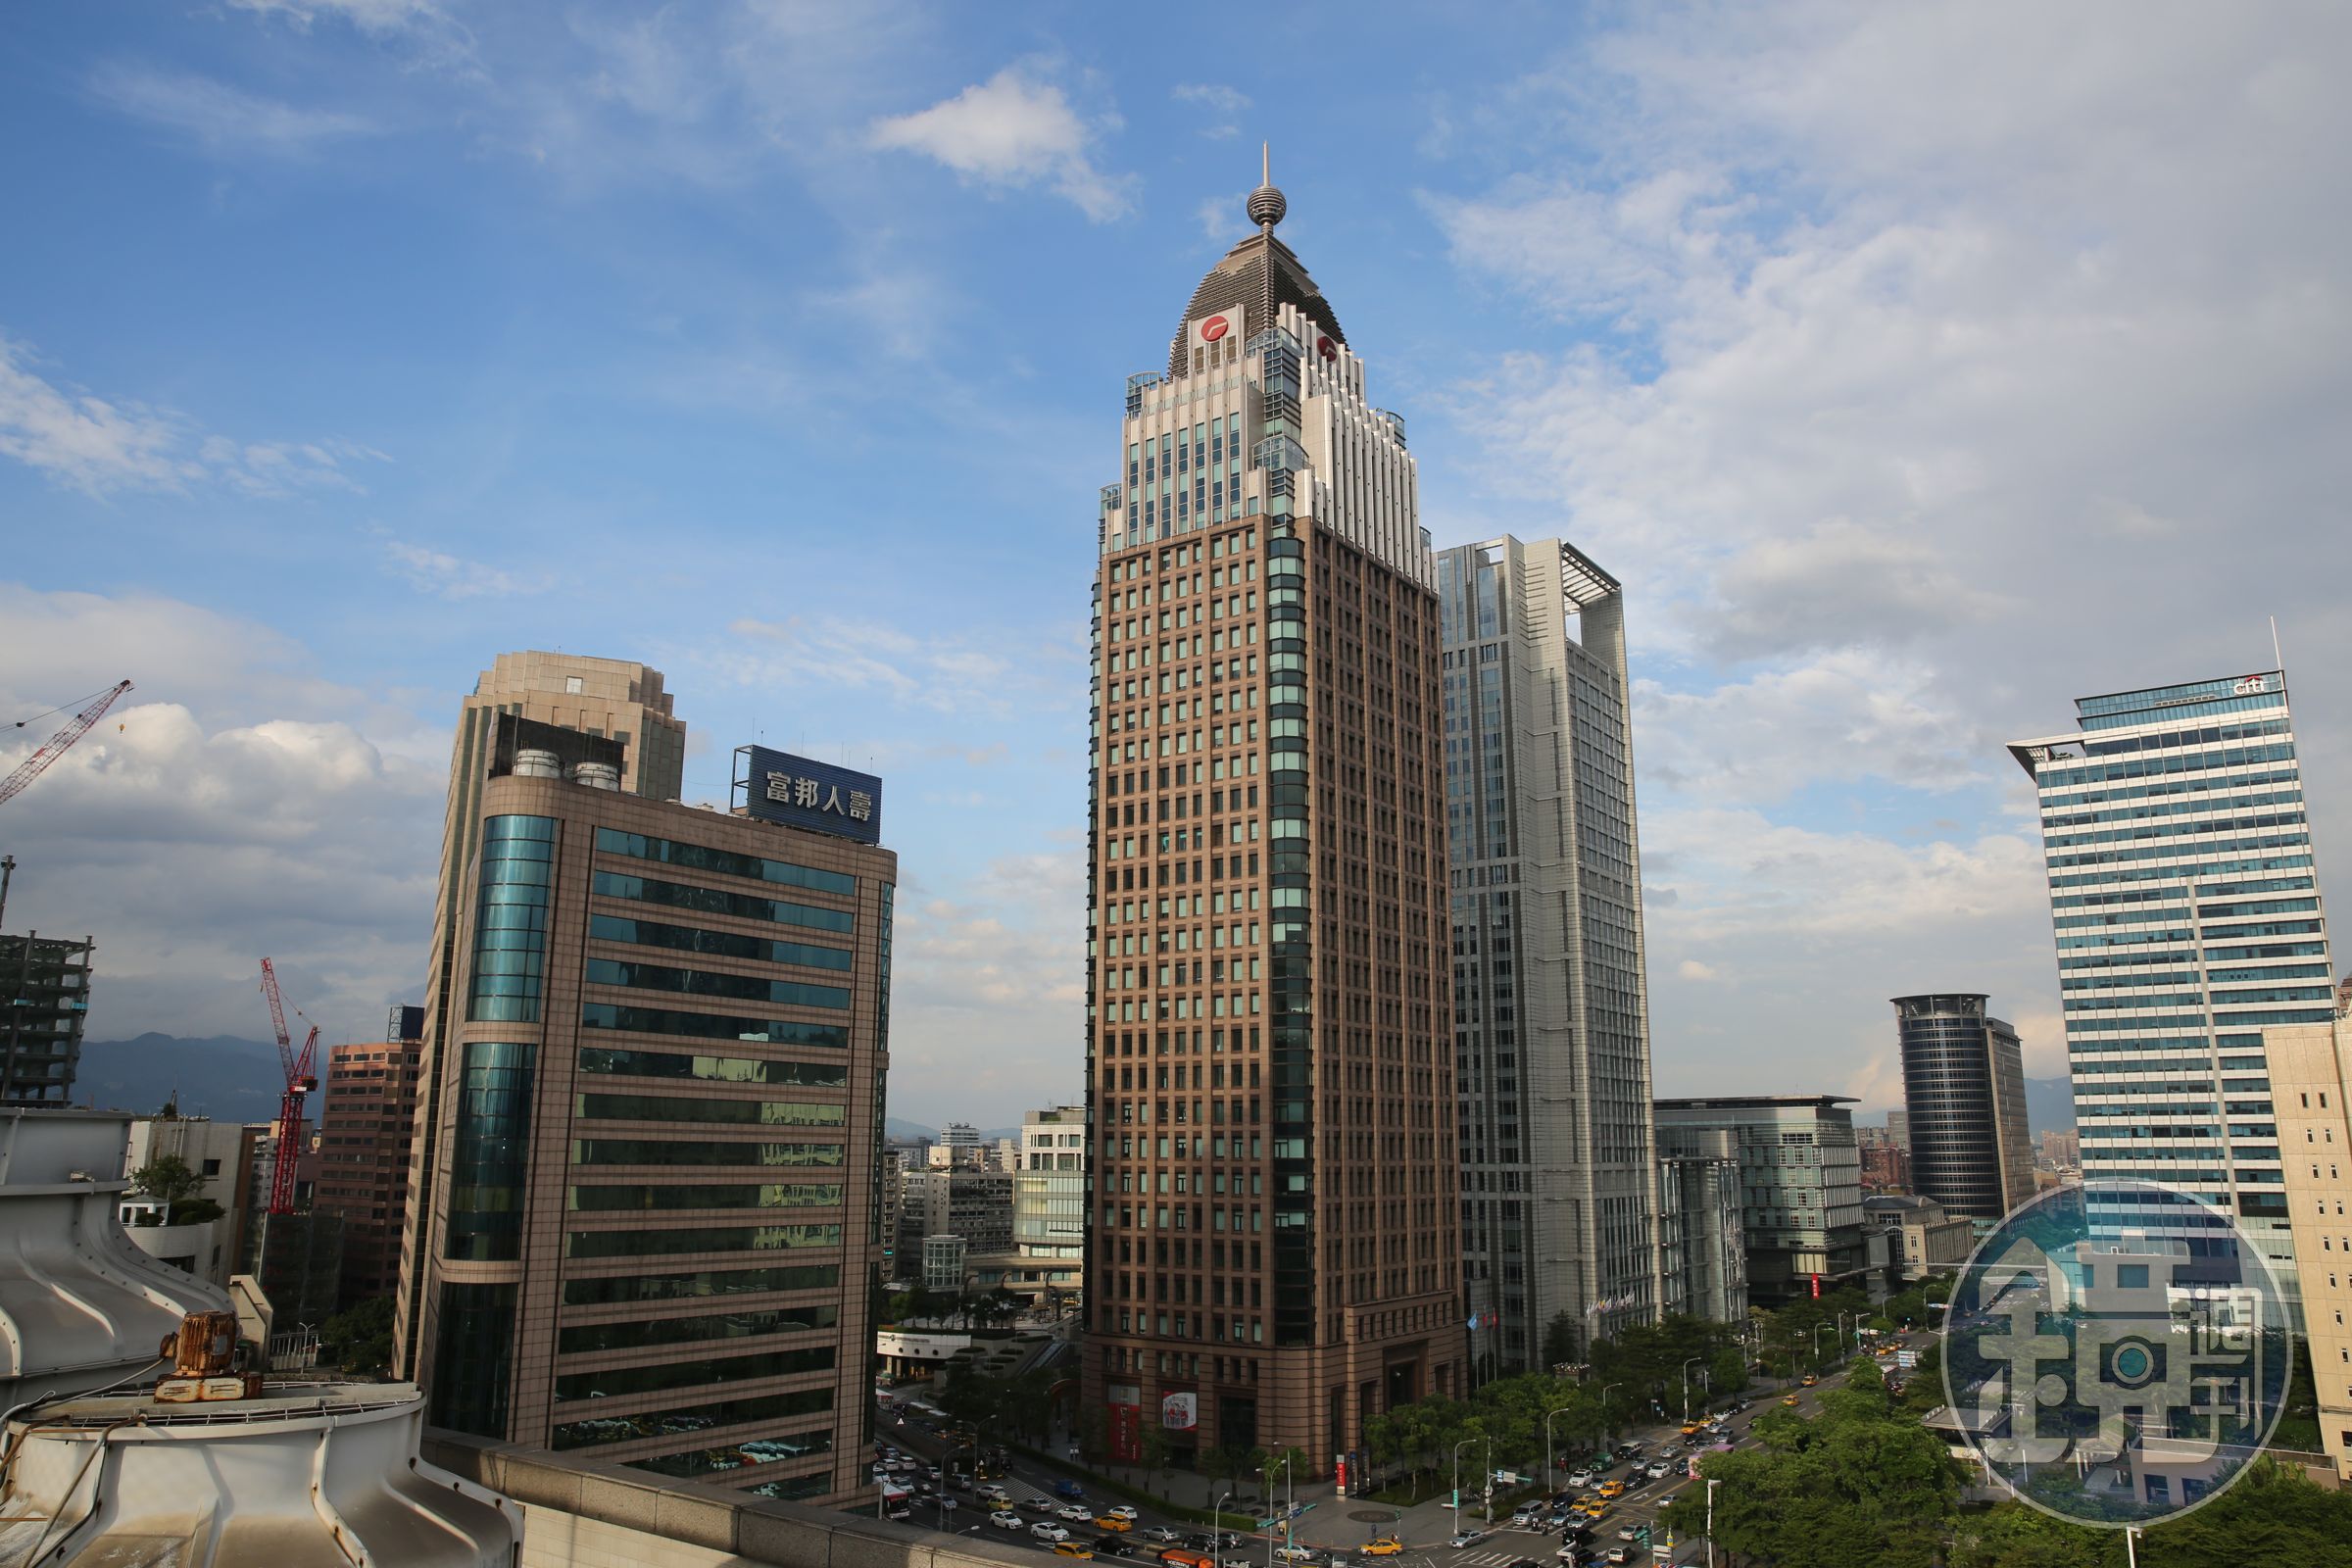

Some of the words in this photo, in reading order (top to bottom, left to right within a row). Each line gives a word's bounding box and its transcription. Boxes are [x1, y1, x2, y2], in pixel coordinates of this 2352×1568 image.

[2233, 677, 2265, 695] citi
[766, 771, 871, 821] 富邦人壽
